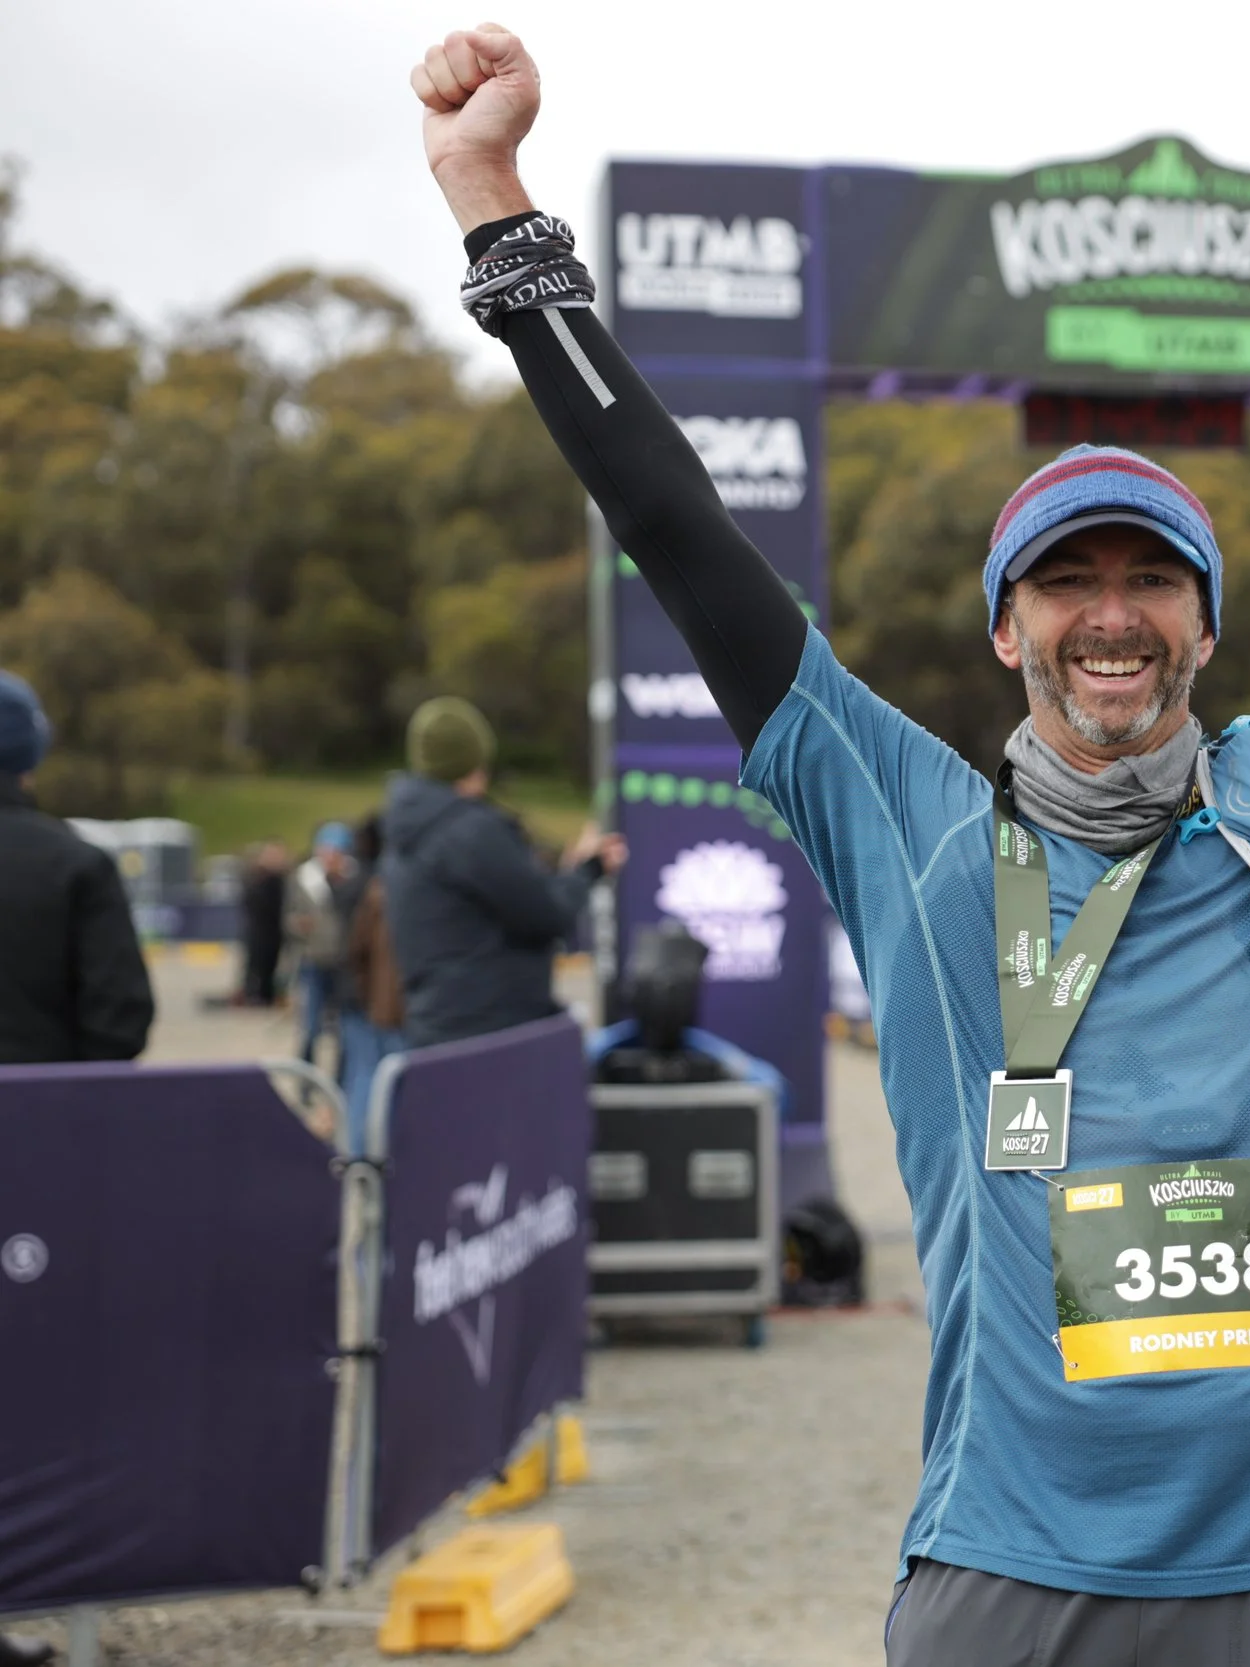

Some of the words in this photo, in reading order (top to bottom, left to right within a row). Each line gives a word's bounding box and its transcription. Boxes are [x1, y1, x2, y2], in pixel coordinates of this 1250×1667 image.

[616, 211, 803, 271] UTMB
[1016, 930, 1035, 988] KOSCIUSZKO
[1052, 953, 1087, 1006] KOSCIUSZKO
[1002, 1137, 1030, 1152] KOSCI
[1030, 1133, 1050, 1155] 27
[1160, 1172, 1181, 1181] ULTRA
[1203, 1170, 1222, 1178] TRAIL
[1098, 1187, 1115, 1205] 27
[1149, 1179, 1235, 1207] KOSCIUSZKO
[1191, 1210, 1216, 1219] UTMB
[1129, 1331, 1217, 1354] RODNEY
